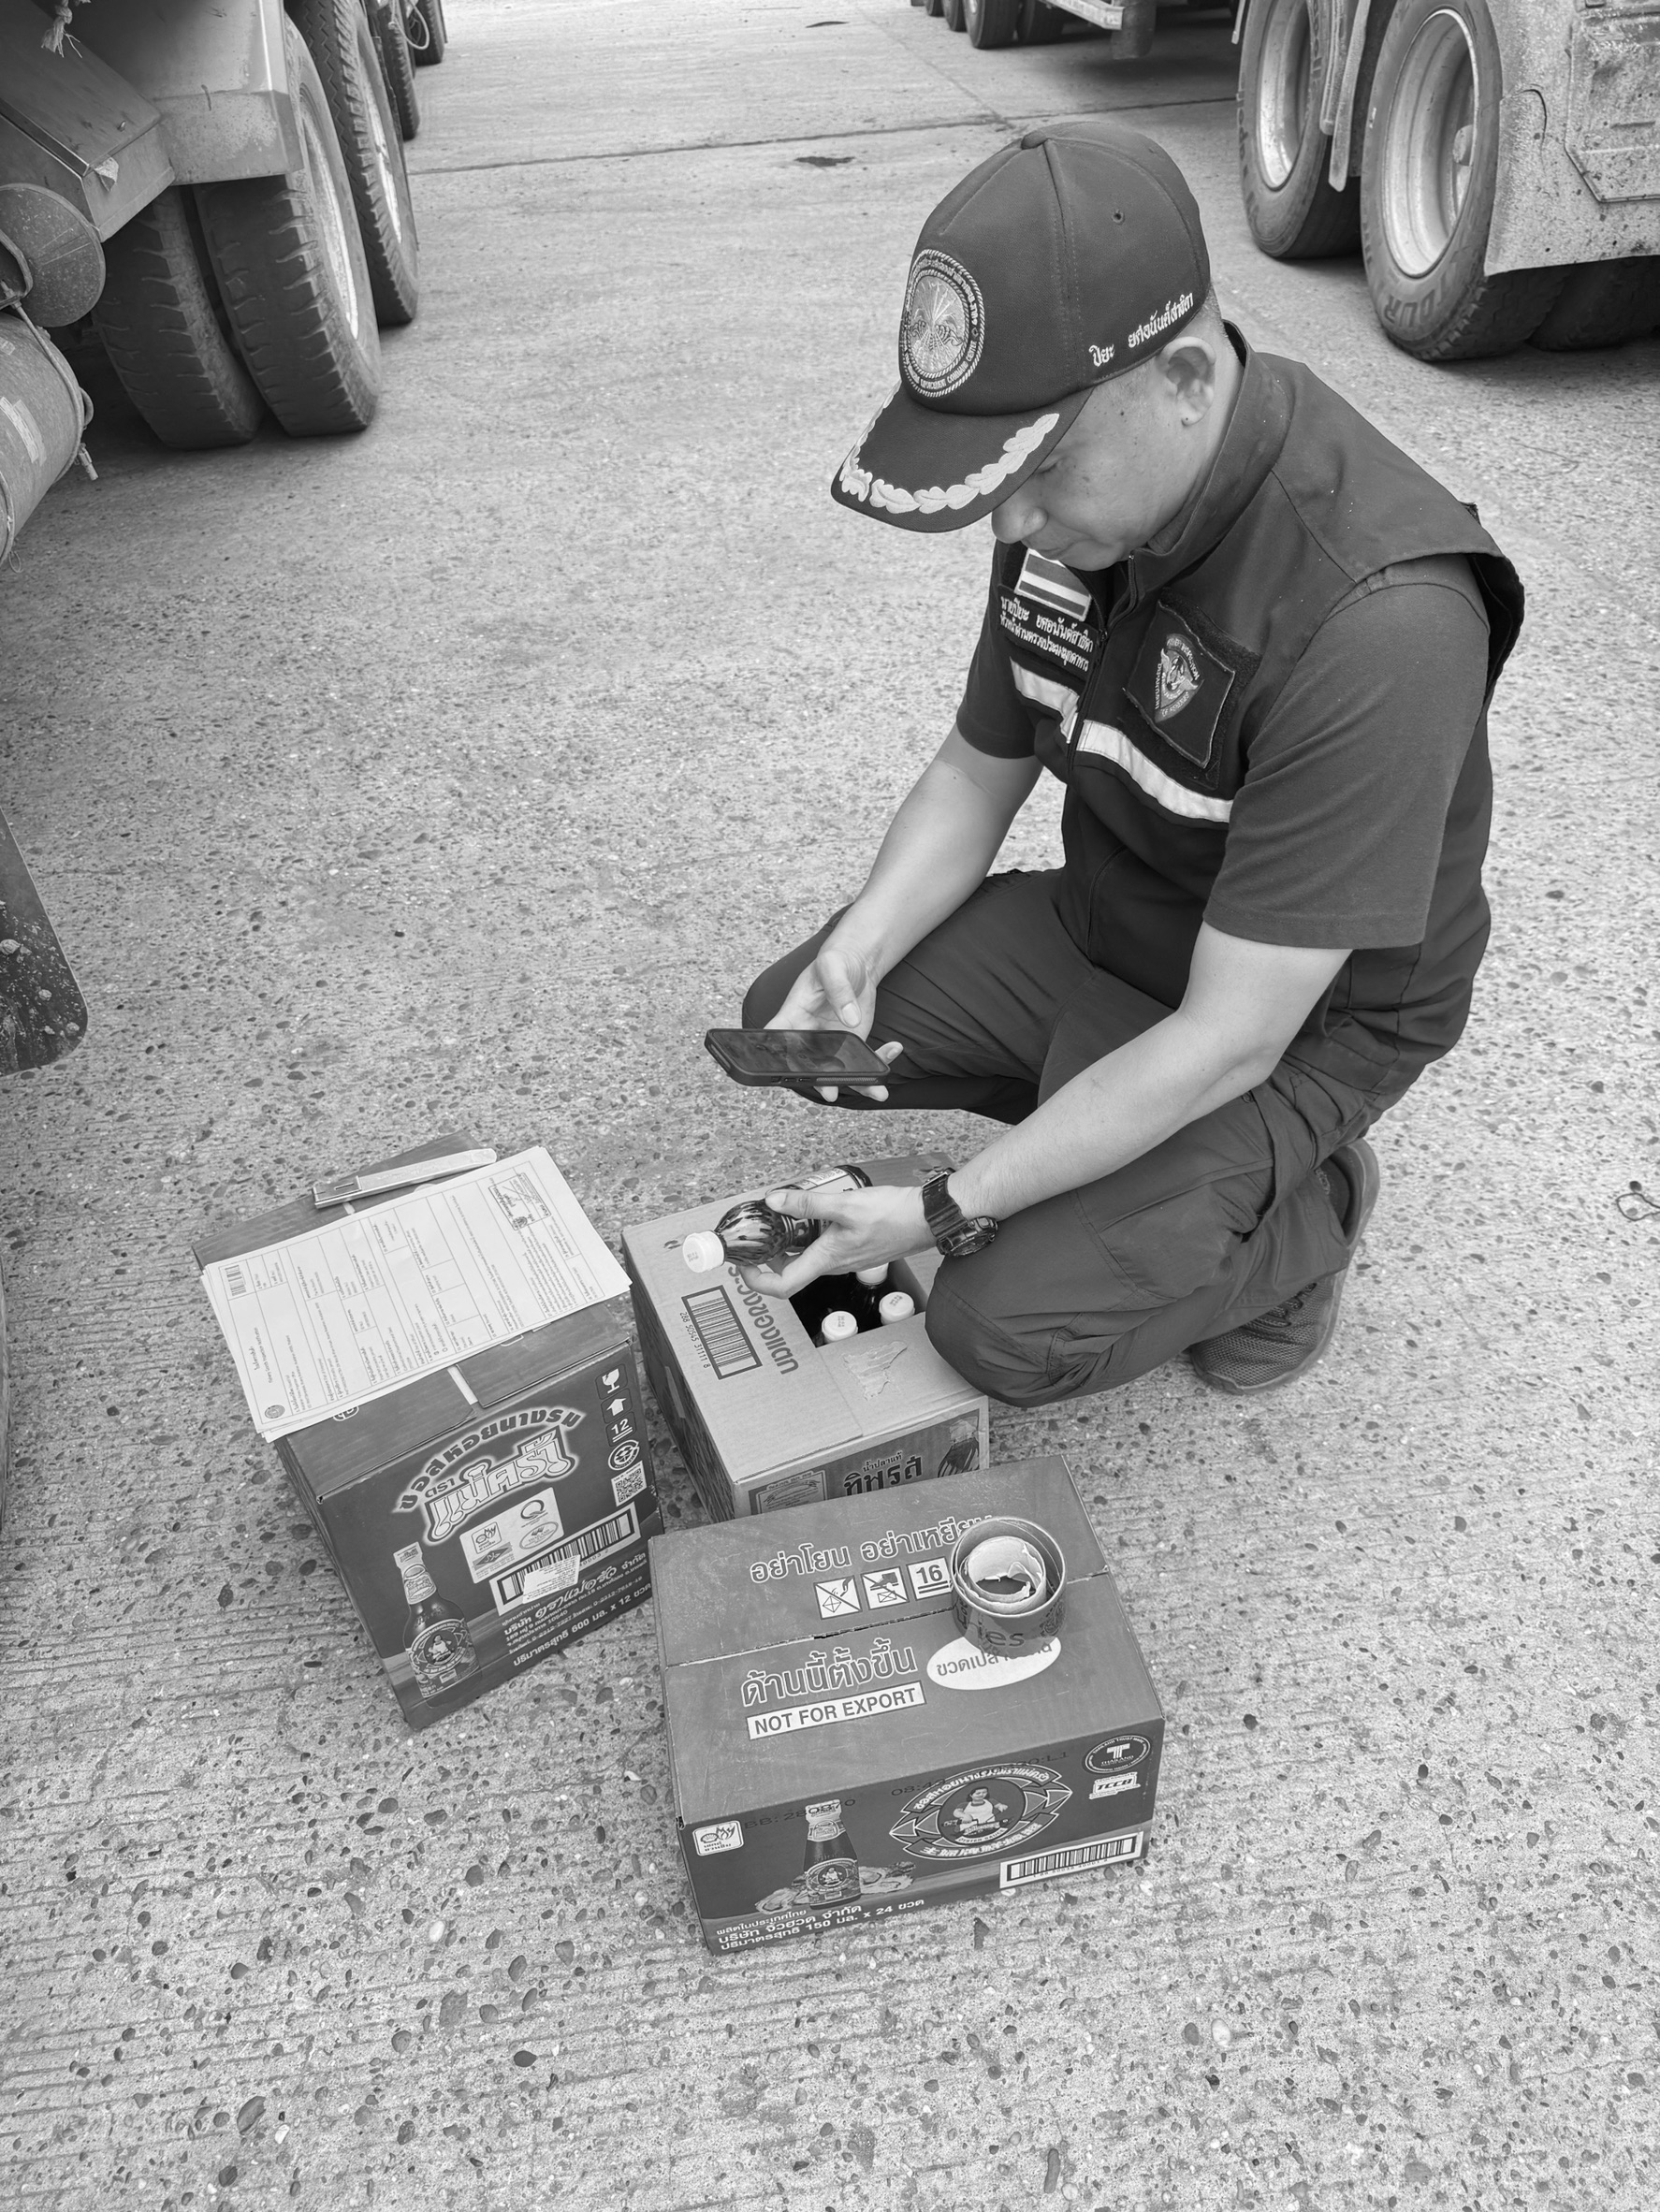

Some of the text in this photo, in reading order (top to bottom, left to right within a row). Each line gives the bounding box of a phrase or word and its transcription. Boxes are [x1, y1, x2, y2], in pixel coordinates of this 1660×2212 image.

[1087, 343, 1115, 368] ปิยะ
[1000, 595, 1030, 621] นายปิยะ
[611, 1419, 630, 1435] 12
[400, 1409, 582, 1509] ซอสหอยนางรม
[862, 1451, 903, 1474] น้ำปลาแท้
[425, 1477, 455, 1499] ตรา
[749, 1542, 853, 1585] อย่าโยน
[915, 1563, 943, 1586] 16
[503, 1614, 532, 1636] บริษัท
[621, 1552, 647, 1571] จำกัด
[571, 1617, 590, 1633] 600
[591, 1607, 608, 1622] มล.
[618, 1594, 631, 1606] 12
[740, 1637, 919, 1708] ด้านนี้ตั้งขึ้น
[754, 1687, 917, 1736] NOT FOR EXPORT
[716, 1909, 808, 1936] ผลิตในประเทศไทย
[719, 1928, 760, 1945] บริษัท
[821, 1904, 862, 1924] จำกัด
[720, 1898, 925, 1951] ปริมาตรสุทธิ 150 มล. x 24 ขวด
